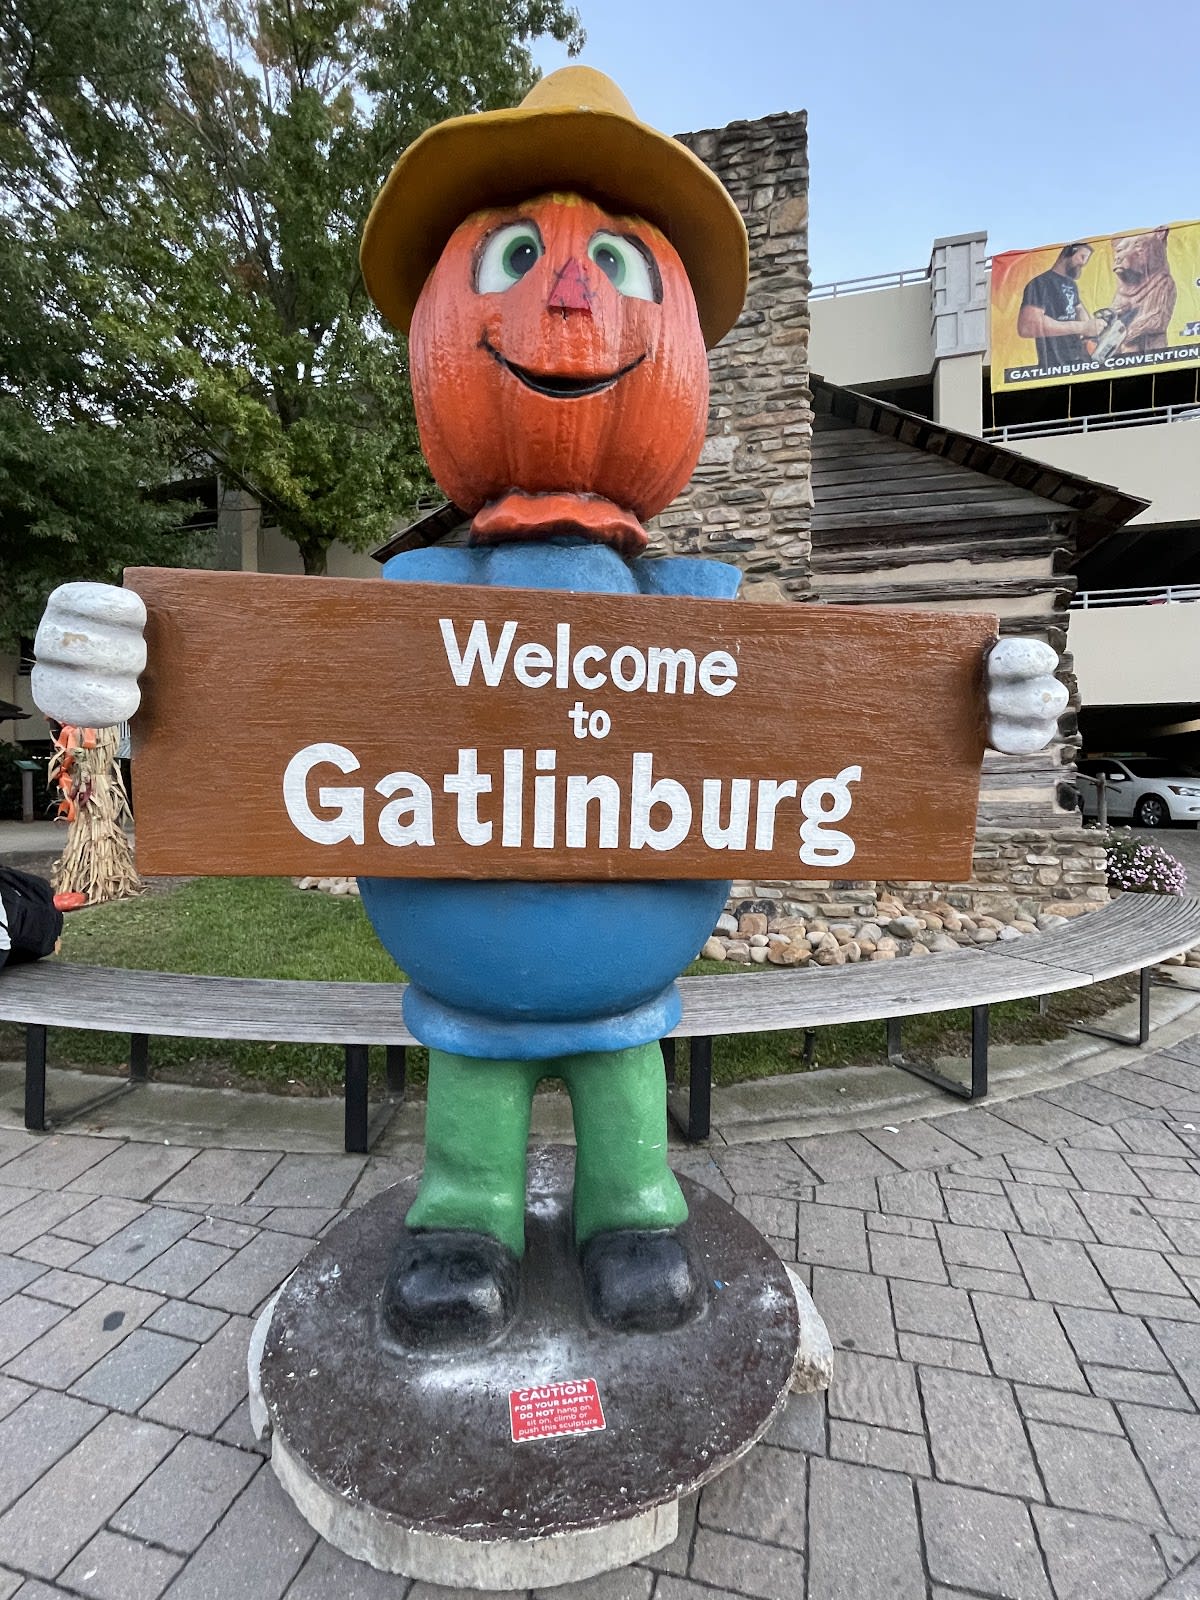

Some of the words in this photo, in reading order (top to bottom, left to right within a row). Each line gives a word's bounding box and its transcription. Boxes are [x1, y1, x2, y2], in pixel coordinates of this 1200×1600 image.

[1010, 362, 1100, 380] GATLINBURG
[1104, 348, 1199, 367] CONVENTION
[438, 618, 739, 696] Welcome
[568, 702, 611, 739] to
[283, 743, 862, 867] Gatlinburg
[519, 1384, 587, 1401] CAUTION
[514, 1404, 532, 1412] FOR
[535, 1400, 560, 1408] YOUR
[562, 1395, 594, 1405] SAFETY
[536, 1409, 554, 1417] NOT
[557, 1405, 577, 1414] hang
[553, 1413, 576, 1422] climb
[519, 1426, 539, 1435] push
[542, 1423, 557, 1431] this
[559, 1419, 597, 1428] sculpture
